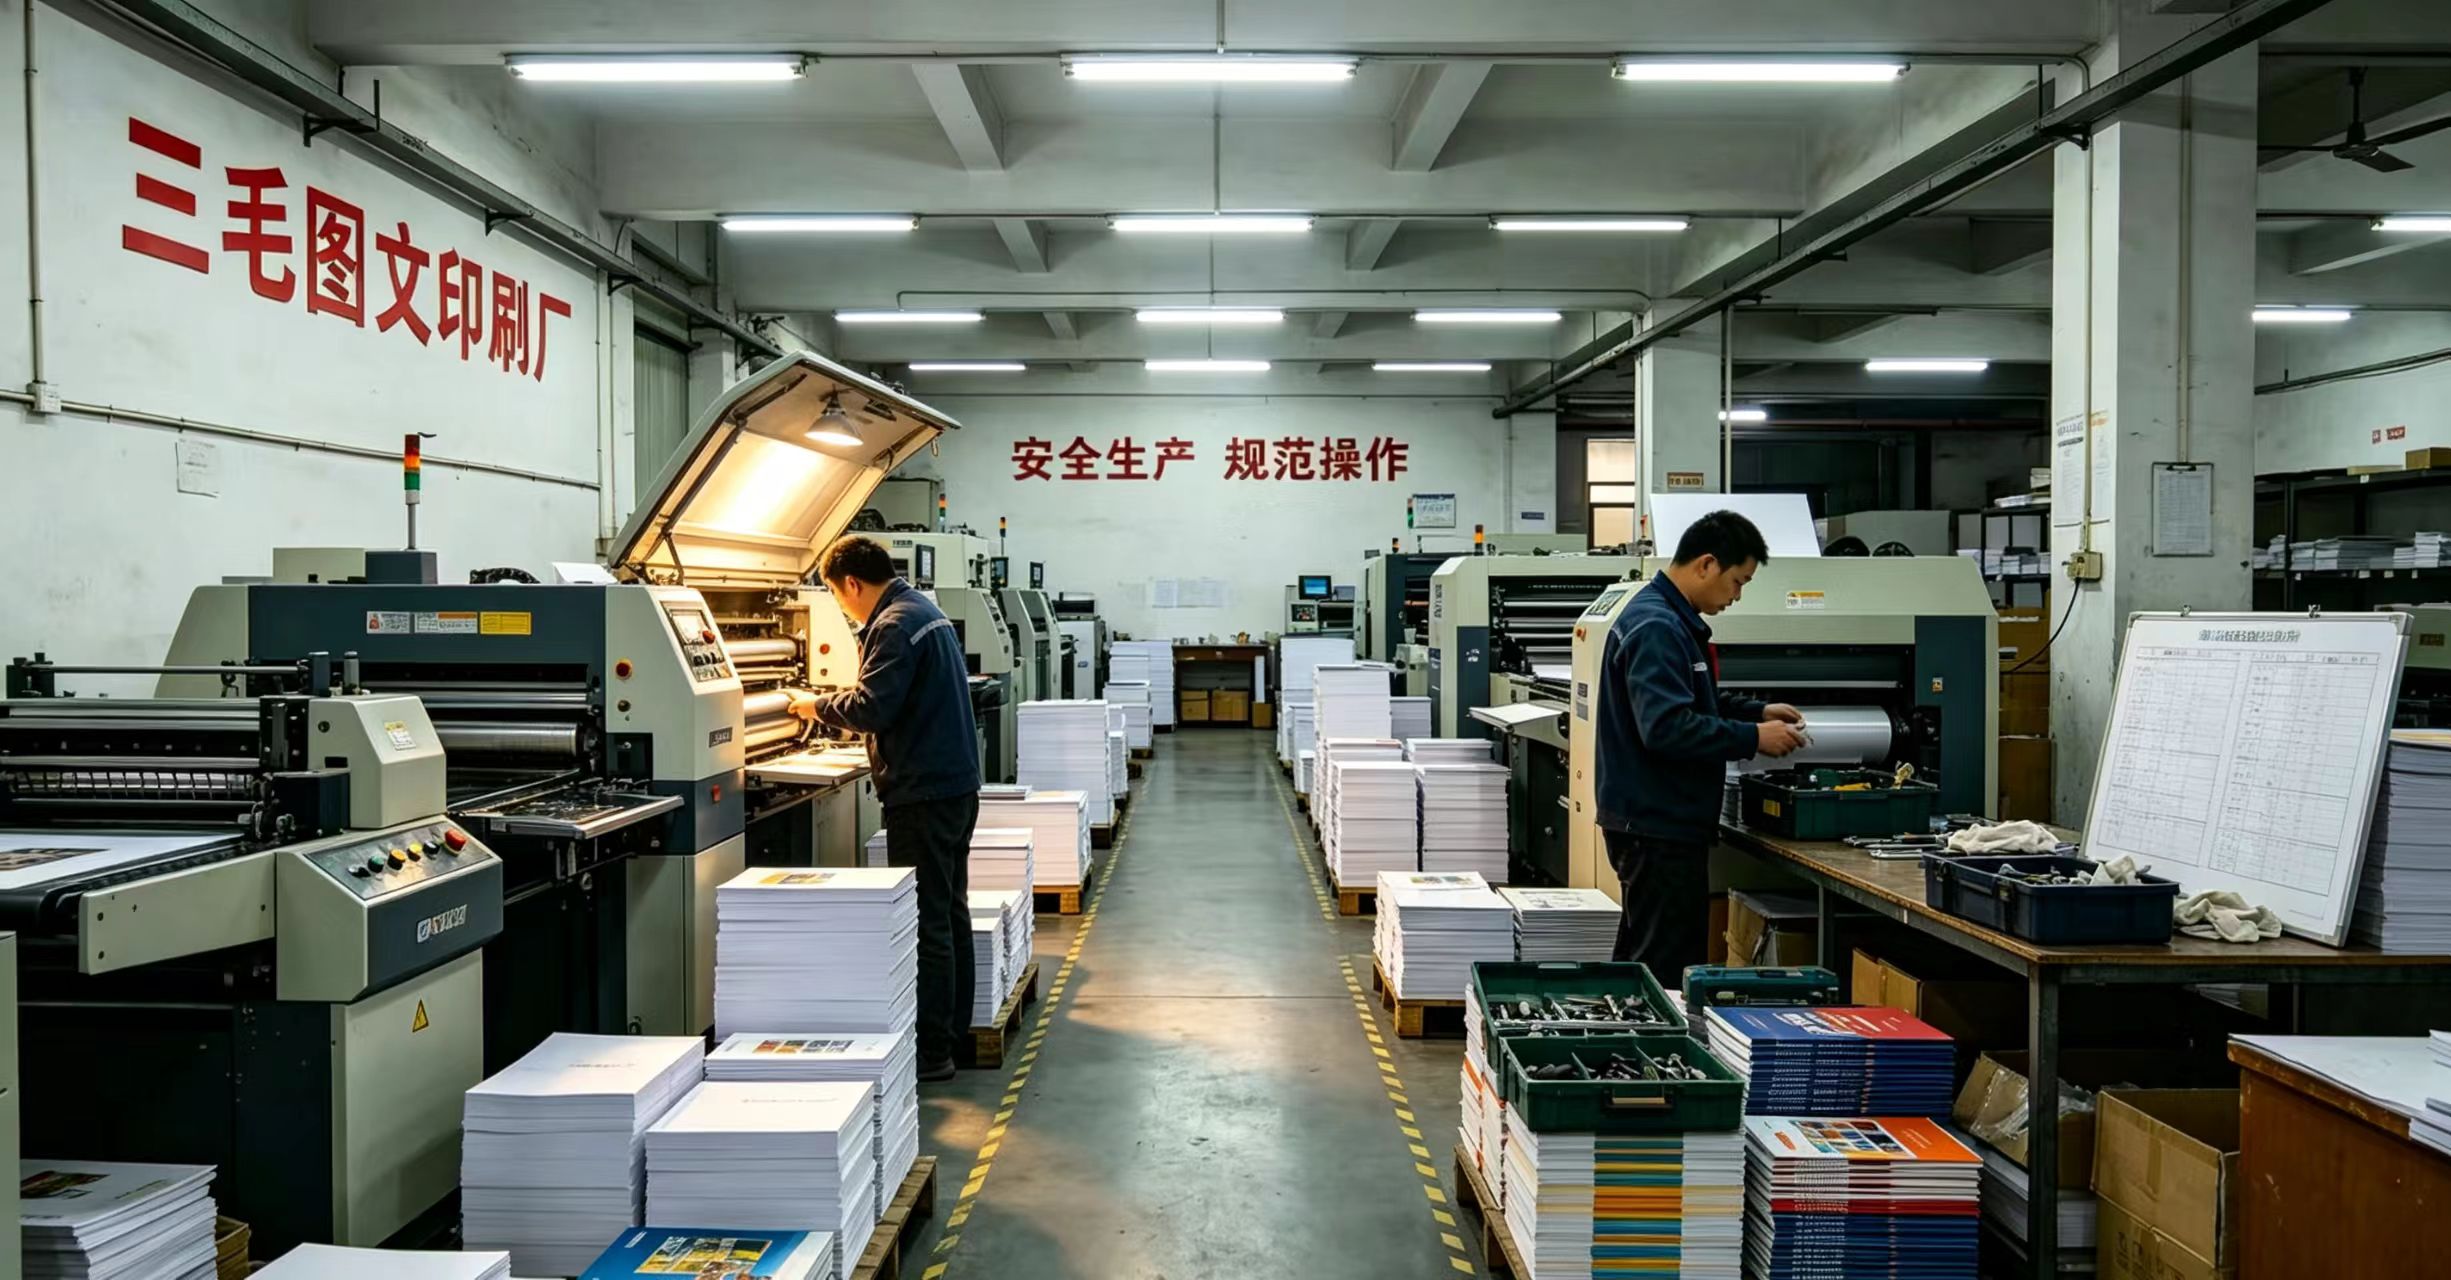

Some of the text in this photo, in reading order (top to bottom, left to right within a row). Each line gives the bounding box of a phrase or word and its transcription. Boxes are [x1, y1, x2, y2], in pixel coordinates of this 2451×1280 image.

[122, 116, 572, 382] 三毛图文印刷厂
[1012, 436, 1409, 482] 安全生产 规范操作
